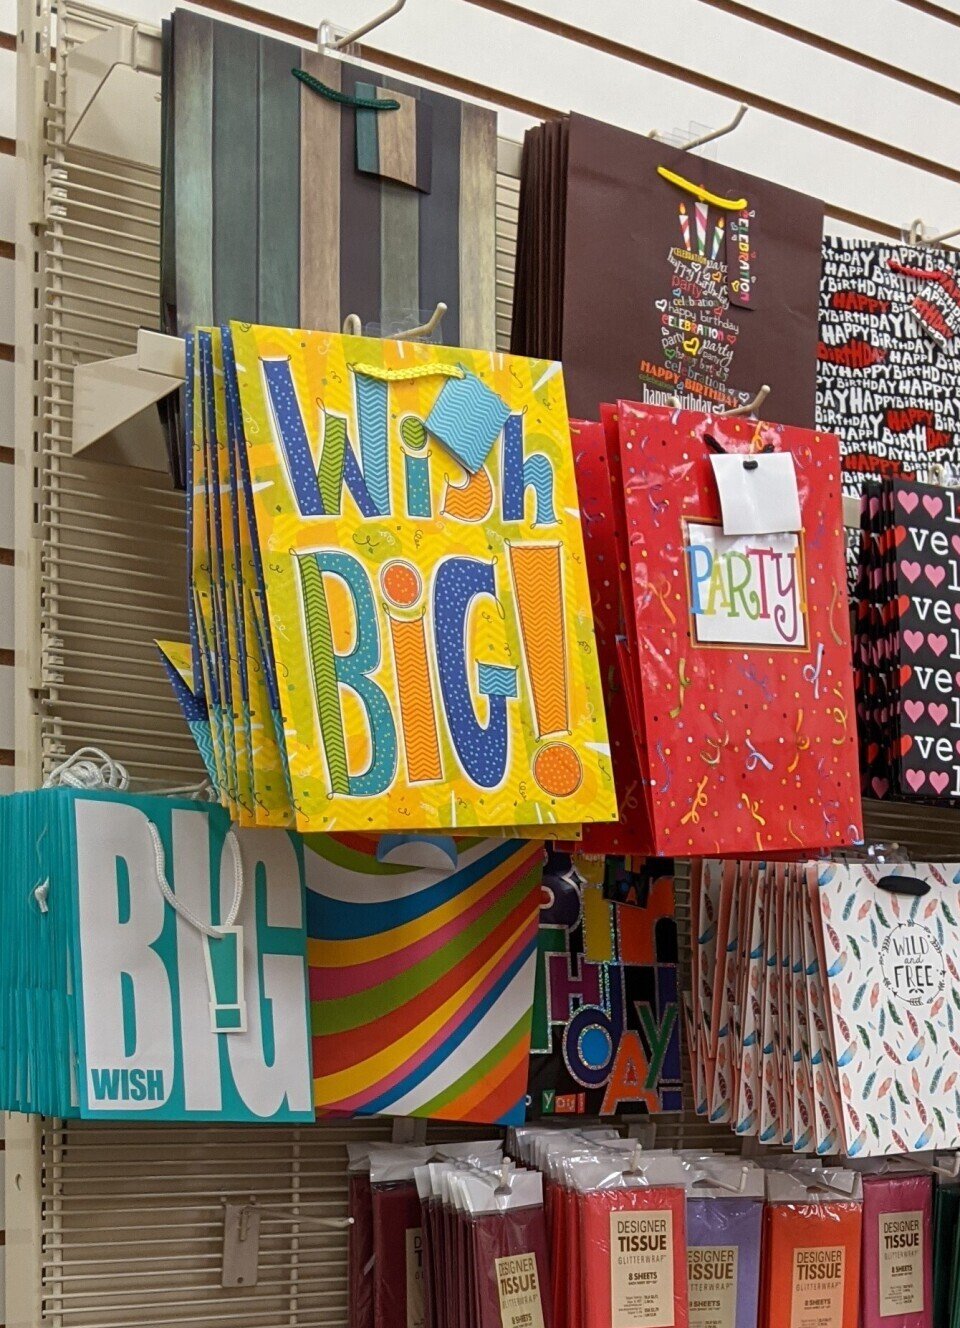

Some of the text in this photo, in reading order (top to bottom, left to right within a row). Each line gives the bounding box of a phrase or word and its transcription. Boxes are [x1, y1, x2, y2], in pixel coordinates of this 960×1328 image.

[668, 302, 740, 335] happy birthday
[640, 360, 680, 385] HAPPY
[683, 377, 738, 408] BIRTHDAY
[685, 545, 799, 643] PARTY
[892, 934, 930, 957] WILD
[903, 955, 925, 965] and
[893, 964, 935, 988] FREE
[91, 1068, 165, 1102] WISH
[618, 1219, 667, 1234] DESIGNER
[884, 1219, 919, 1233] DESIGNER
[618, 1235, 667, 1252] TISSUE
[884, 1233, 920, 1249] TISSUE
[688, 1250, 734, 1263] ESIGNER
[797, 1249, 842, 1264] DESIGNER
[498, 1257, 534, 1277] DESIGNER
[634, 1271, 658, 1280] SHEETS
[688, 1262, 734, 1280] ISSUE
[797, 1262, 842, 1281] TISSUE
[500, 1273, 537, 1296] TISSUE
